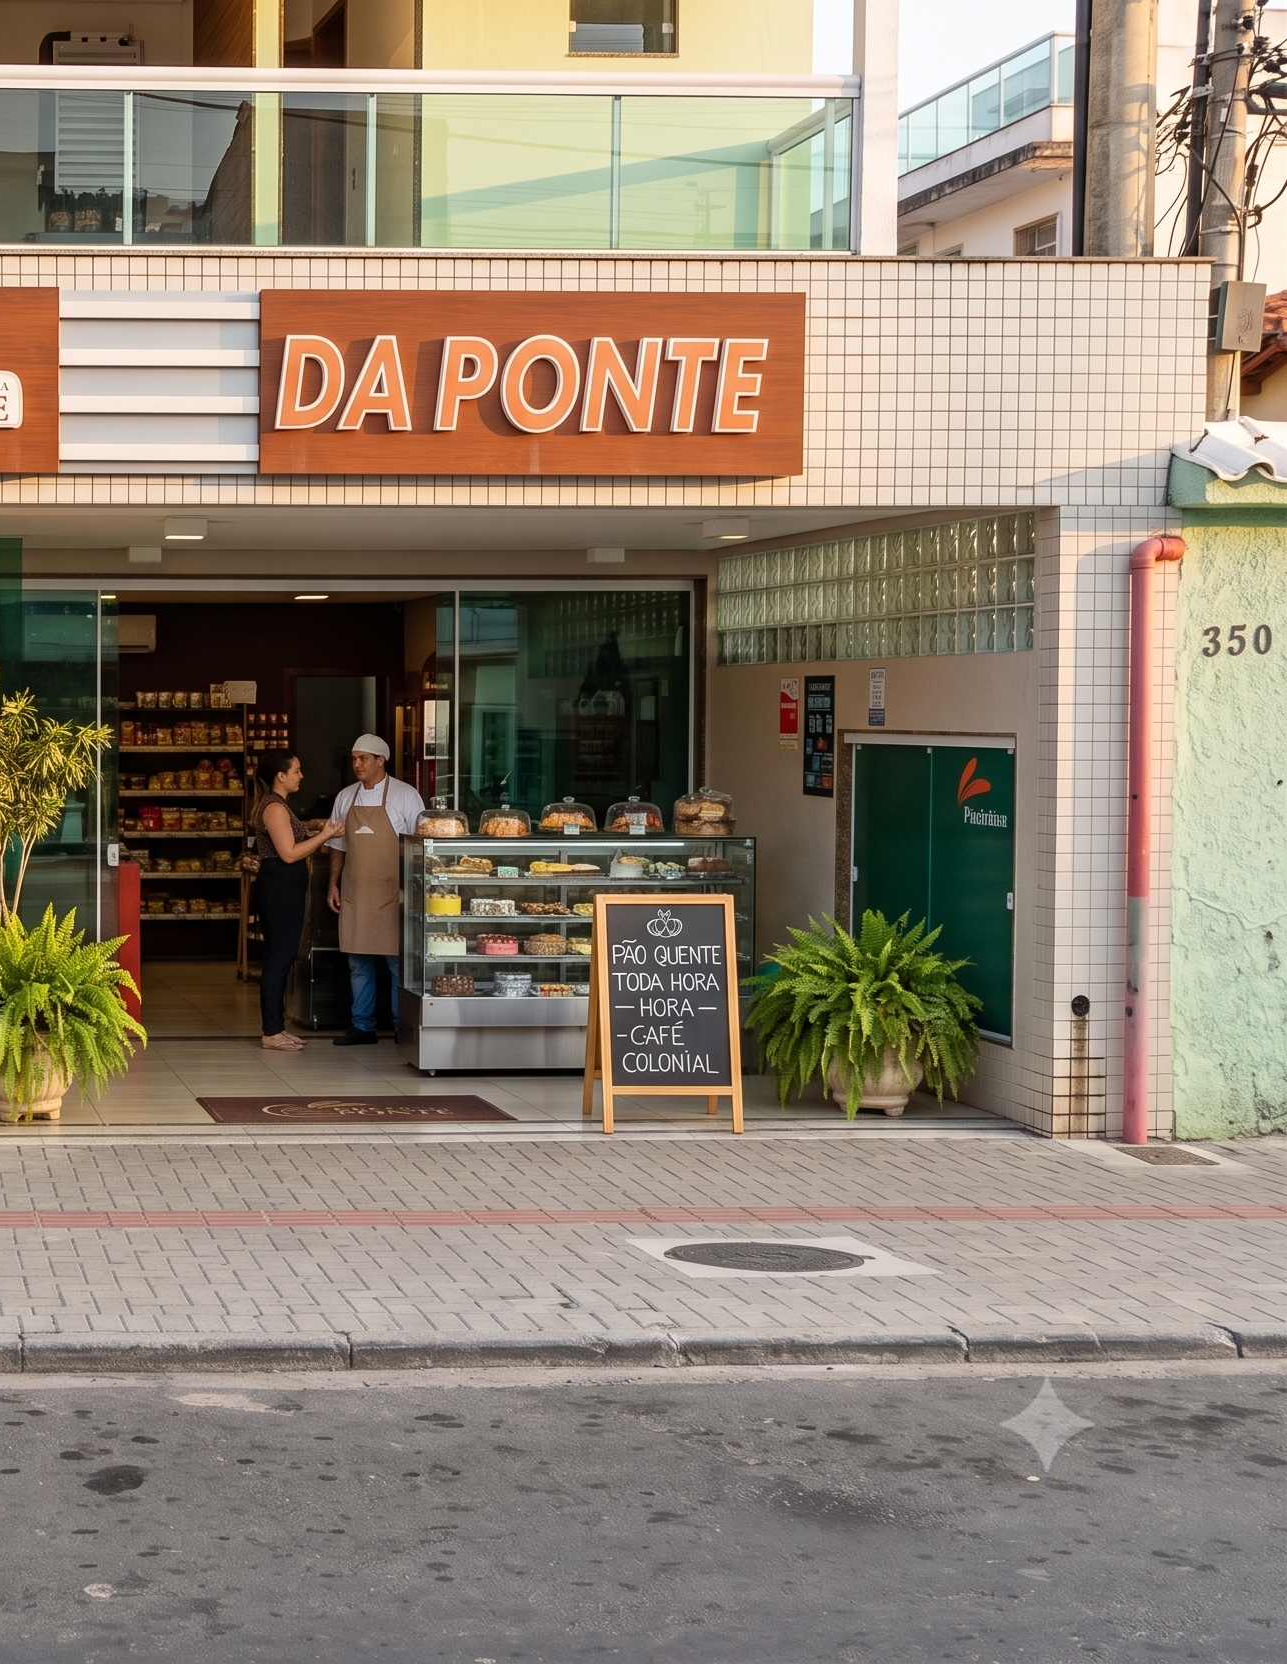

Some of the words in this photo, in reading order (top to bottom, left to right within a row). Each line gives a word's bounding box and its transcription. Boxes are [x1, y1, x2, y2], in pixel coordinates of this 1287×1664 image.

[274, 334, 413, 431] DA
[433, 333, 770, 434] PONTE
[1201, 623, 1273, 658] 350
[612, 939, 647, 965] PÃO
[654, 945, 722, 966] QUENTE
[611, 972, 664, 992] TODA
[670, 972, 721, 992] HORA
[639, 997, 695, 1018] HORA
[622, 1049, 720, 1074] COLONIAL
